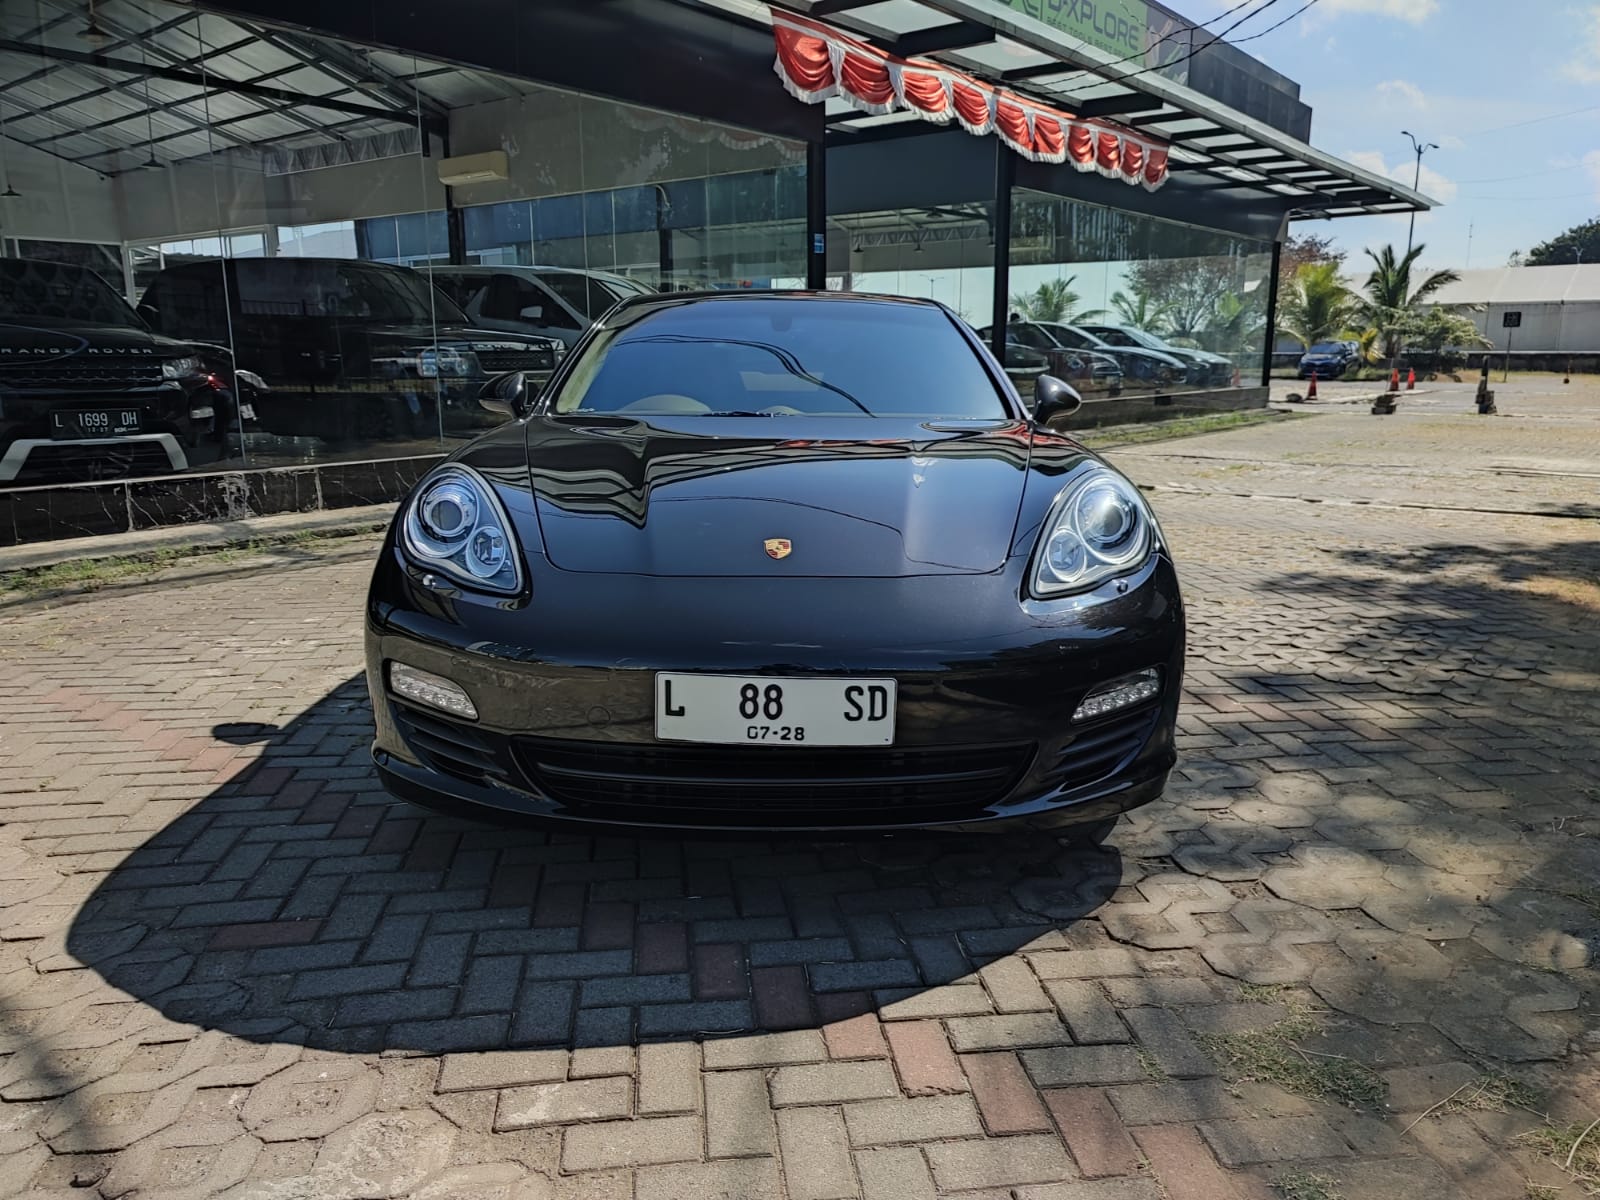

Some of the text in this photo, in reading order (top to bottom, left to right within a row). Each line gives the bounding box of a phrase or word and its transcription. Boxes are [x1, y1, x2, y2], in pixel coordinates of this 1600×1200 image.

[54, 411, 138, 428] L 1699 DH
[664, 679, 888, 722] L 88 SD
